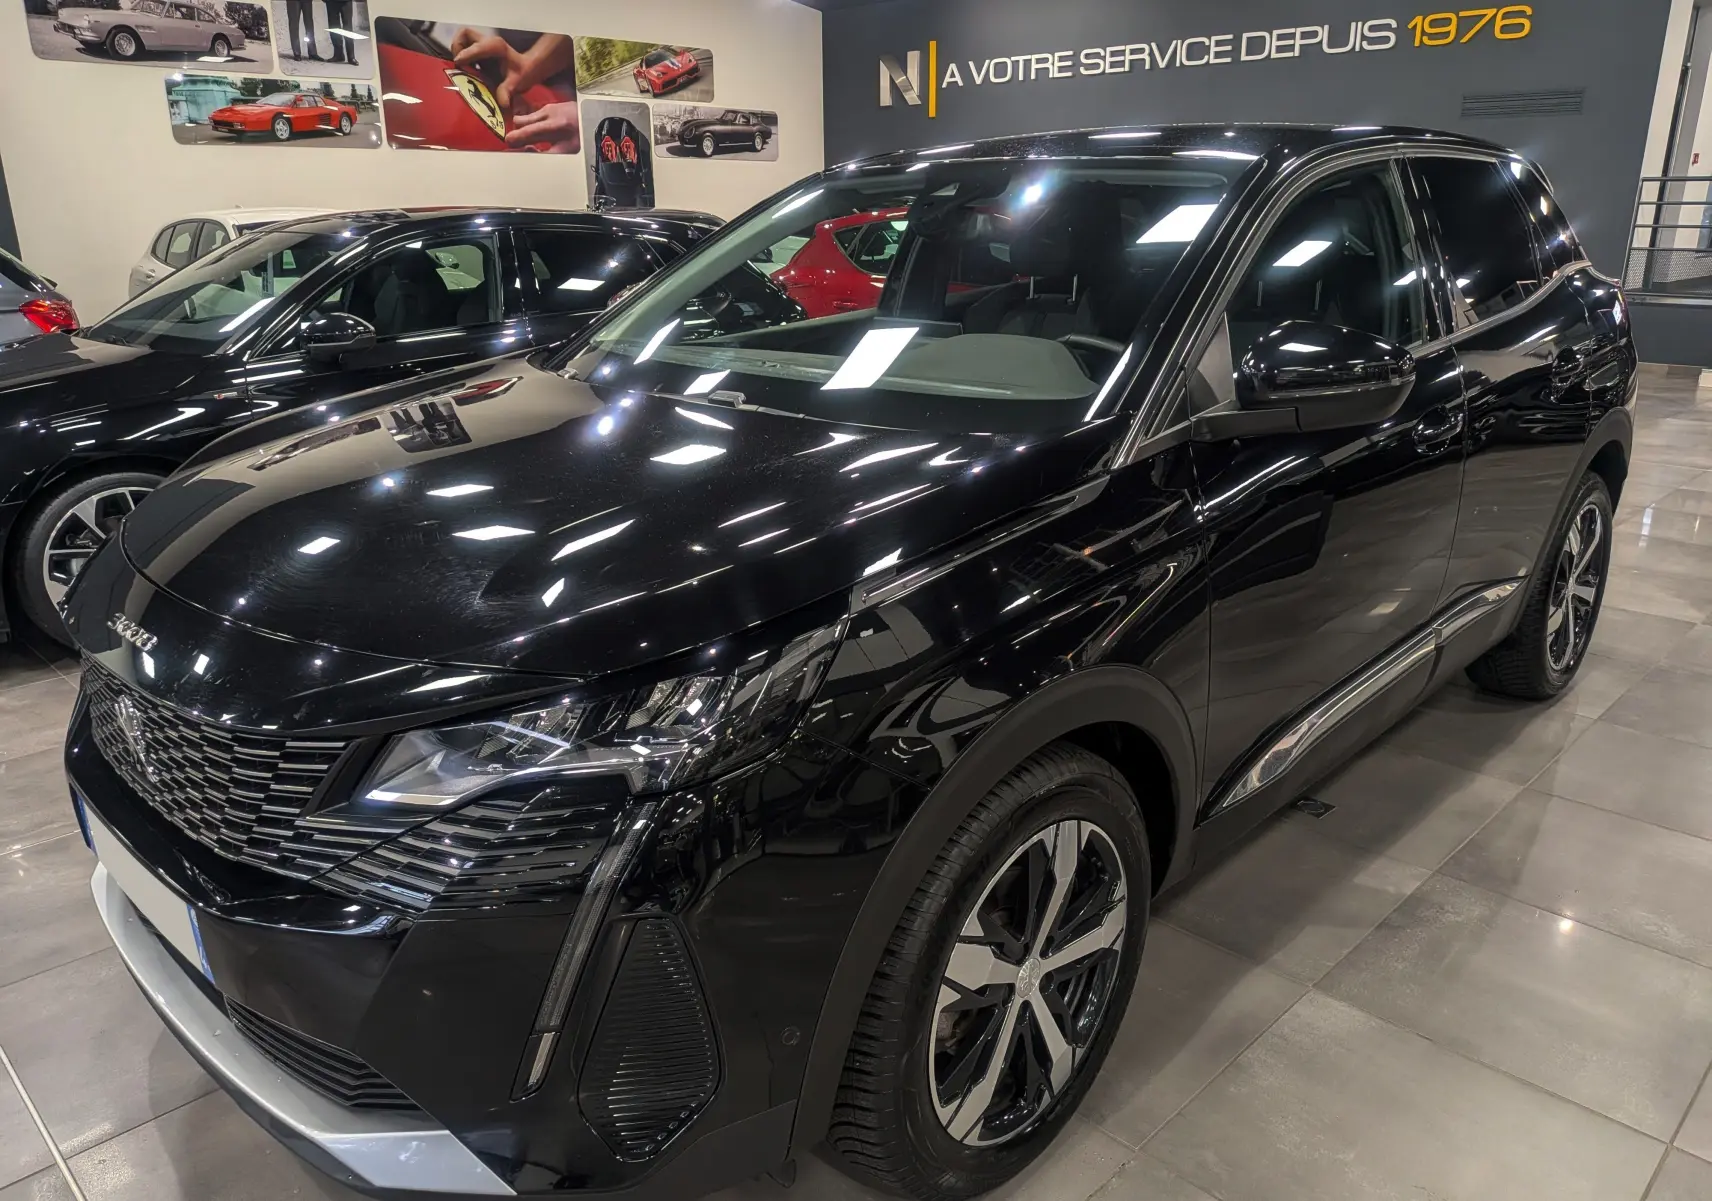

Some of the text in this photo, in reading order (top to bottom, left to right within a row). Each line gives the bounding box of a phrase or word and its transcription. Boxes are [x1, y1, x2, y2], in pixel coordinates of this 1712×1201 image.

[941, 5, 1533, 88] A VOTRE SERVICE DEPUIS 1976
[879, 50, 921, 106] N
[107, 612, 158, 652] 3008
